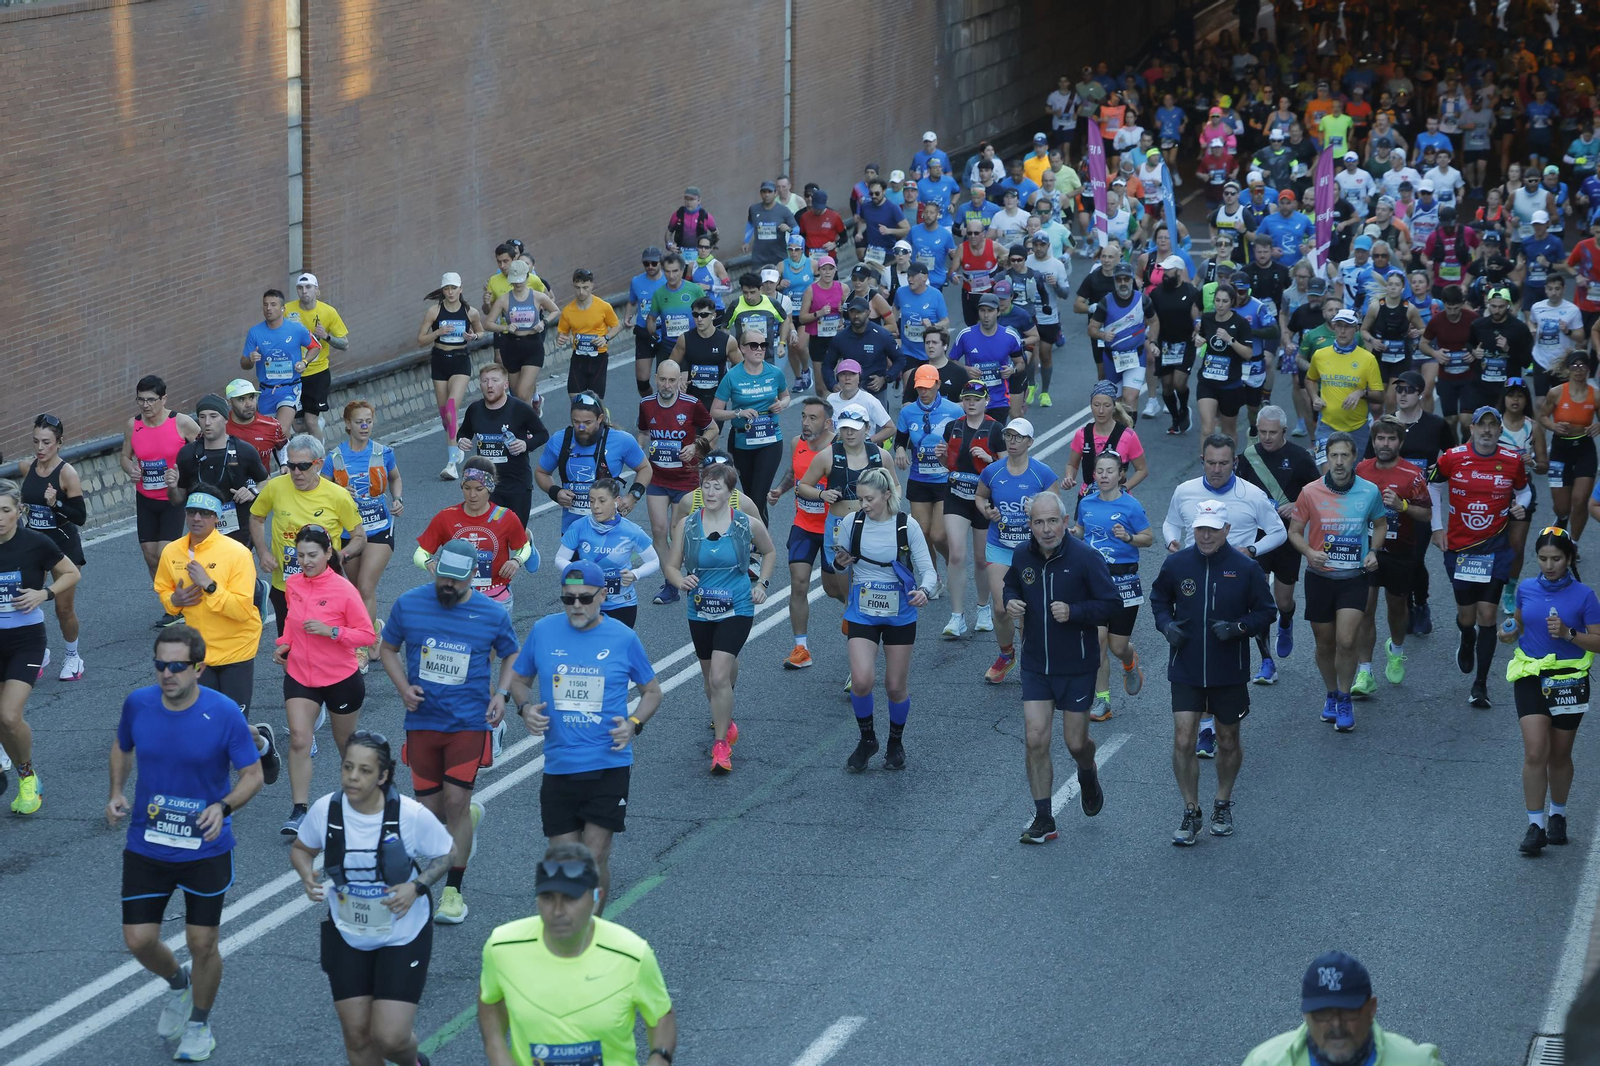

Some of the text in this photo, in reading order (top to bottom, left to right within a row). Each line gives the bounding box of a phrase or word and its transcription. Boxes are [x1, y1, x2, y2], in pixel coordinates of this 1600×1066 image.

[755, 430, 767, 438] MIA
[480, 448, 504, 456] REEVESY
[1000, 532, 1031, 540] SEVERINE
[1461, 565, 1487, 575] RAMÓN
[867, 600, 890, 609] FIONA
[701, 606, 726, 614] SARAH
[439, 642, 466, 651] ZURICH
[436, 654, 454, 663] 10618
[426, 661, 460, 675] MARLIV
[565, 689, 589, 699] ALEX
[1554, 695, 1577, 705] YANN
[168, 800, 200, 809] ZURICH
[351, 887, 382, 896] ZURICH
[354, 912, 368, 924] RU
[1317, 966, 1343, 990] NY
[553, 1045, 593, 1056] ZURICH
